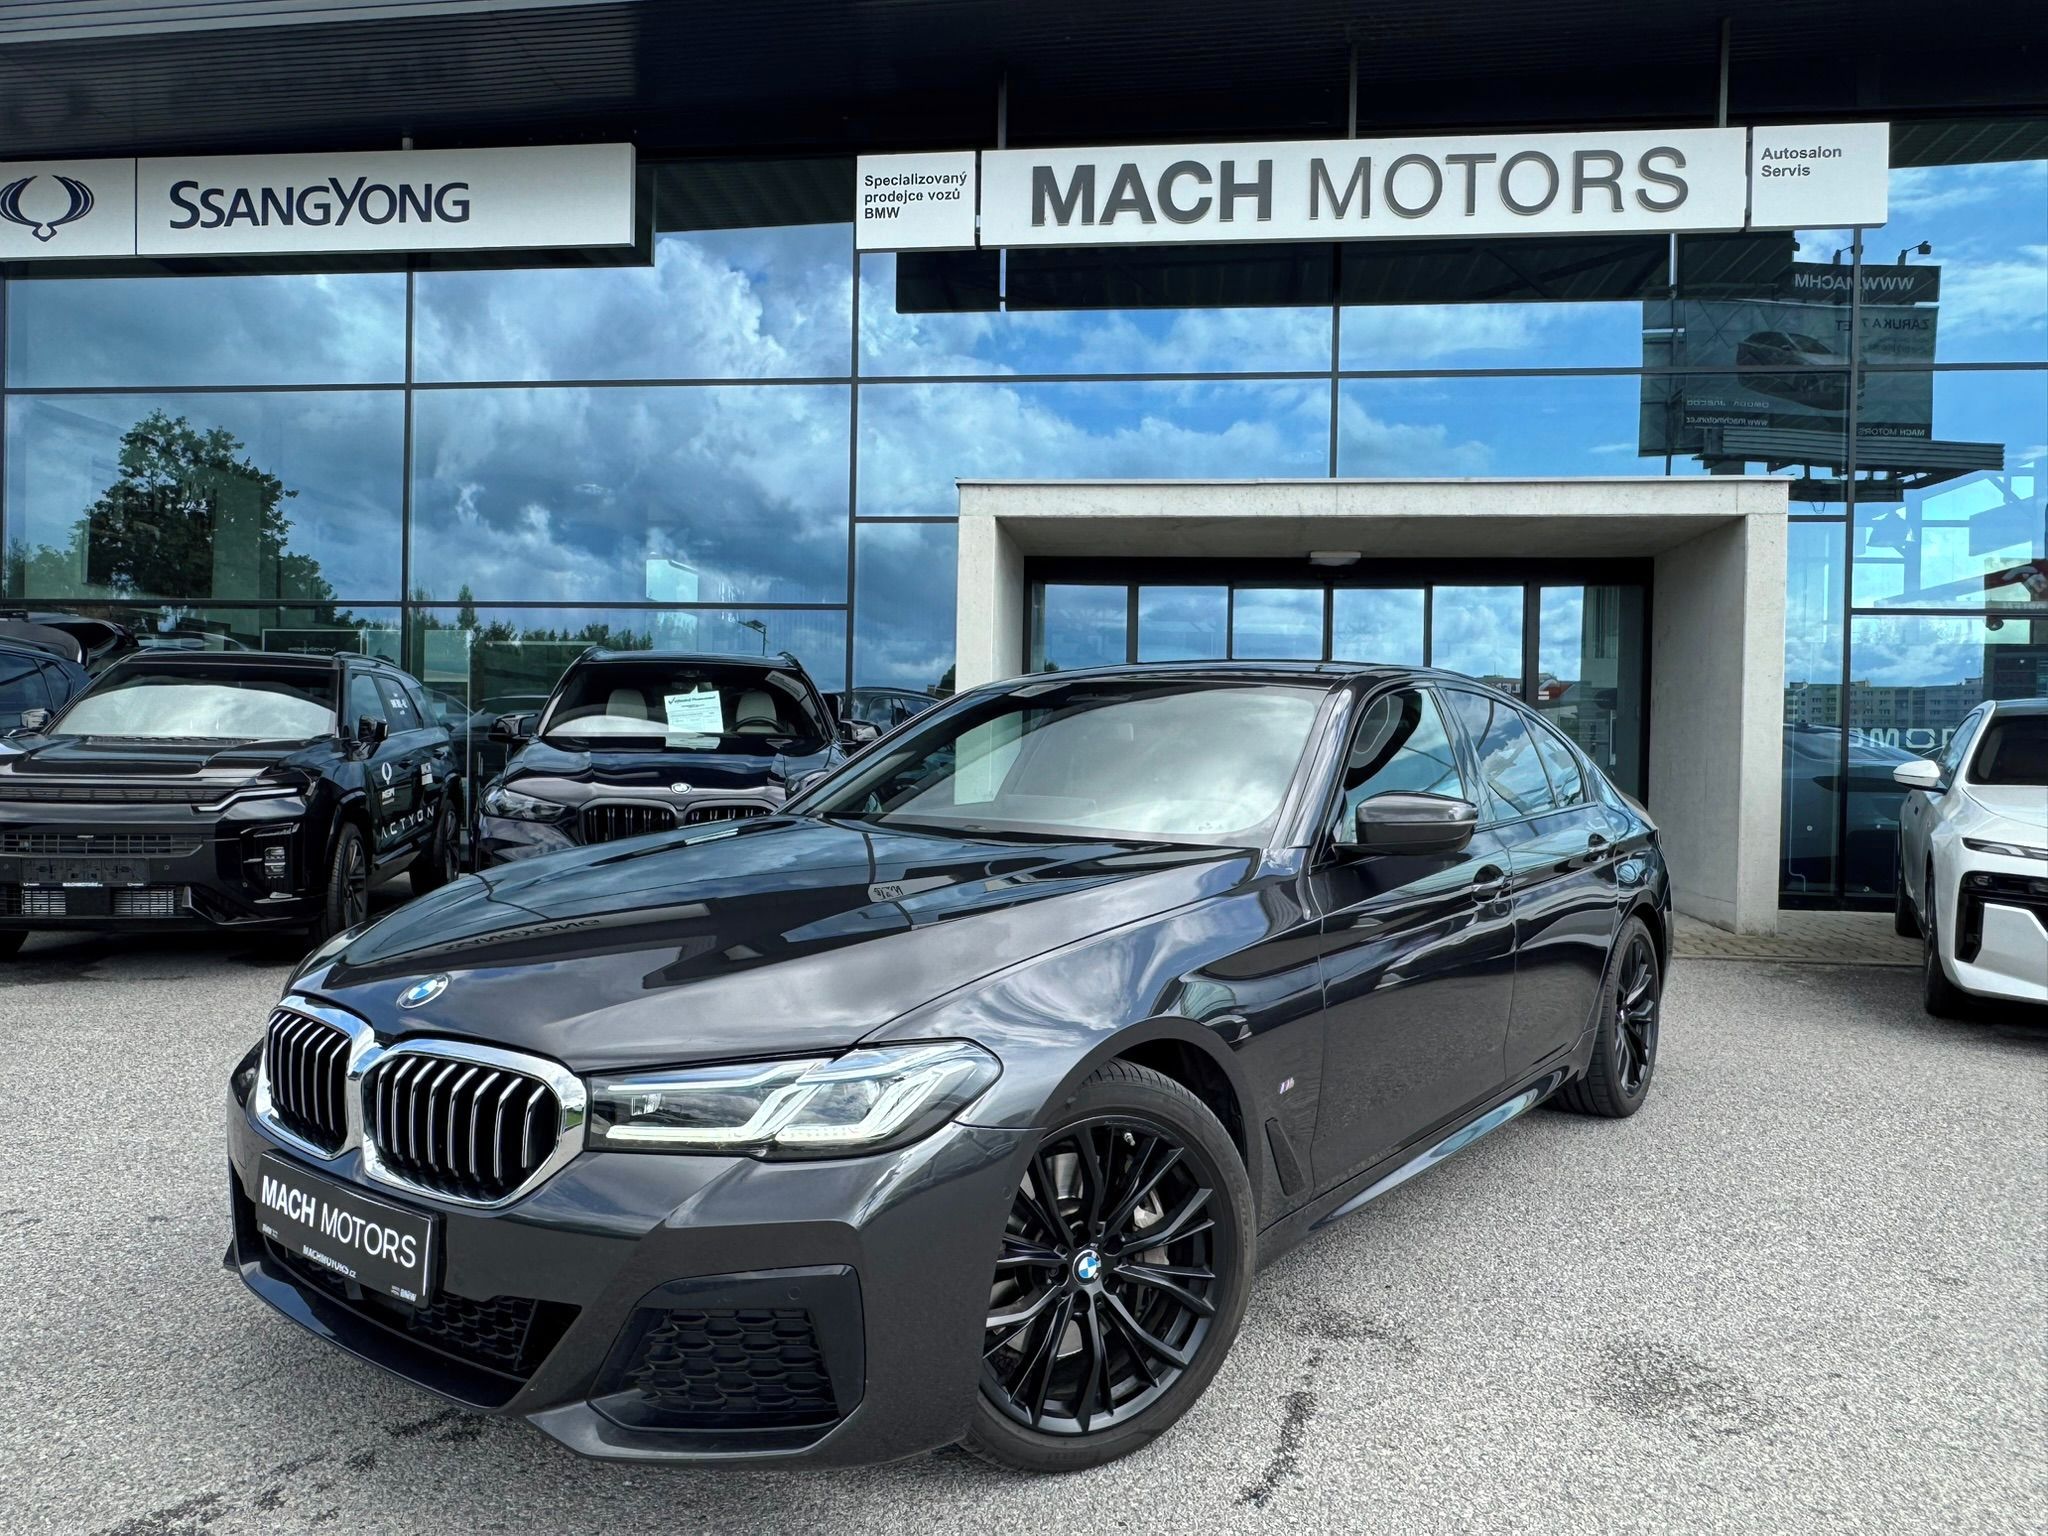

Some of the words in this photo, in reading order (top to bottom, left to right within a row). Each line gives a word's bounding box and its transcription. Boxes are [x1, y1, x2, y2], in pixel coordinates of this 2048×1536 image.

[1761, 146, 1842, 160] Autosalon
[1761, 164, 1811, 177] Servis
[864, 171, 968, 189] Specializovaný
[1031, 158, 1274, 227] MACH
[1310, 146, 1690, 220] MOTORS
[864, 190, 924, 205] prodejce
[927, 188, 961, 201] vozů
[864, 207, 900, 219] BMW
[380, 805, 436, 840] ACTYON
[261, 1175, 317, 1228] MACH
[320, 1202, 417, 1269] MOTORS
